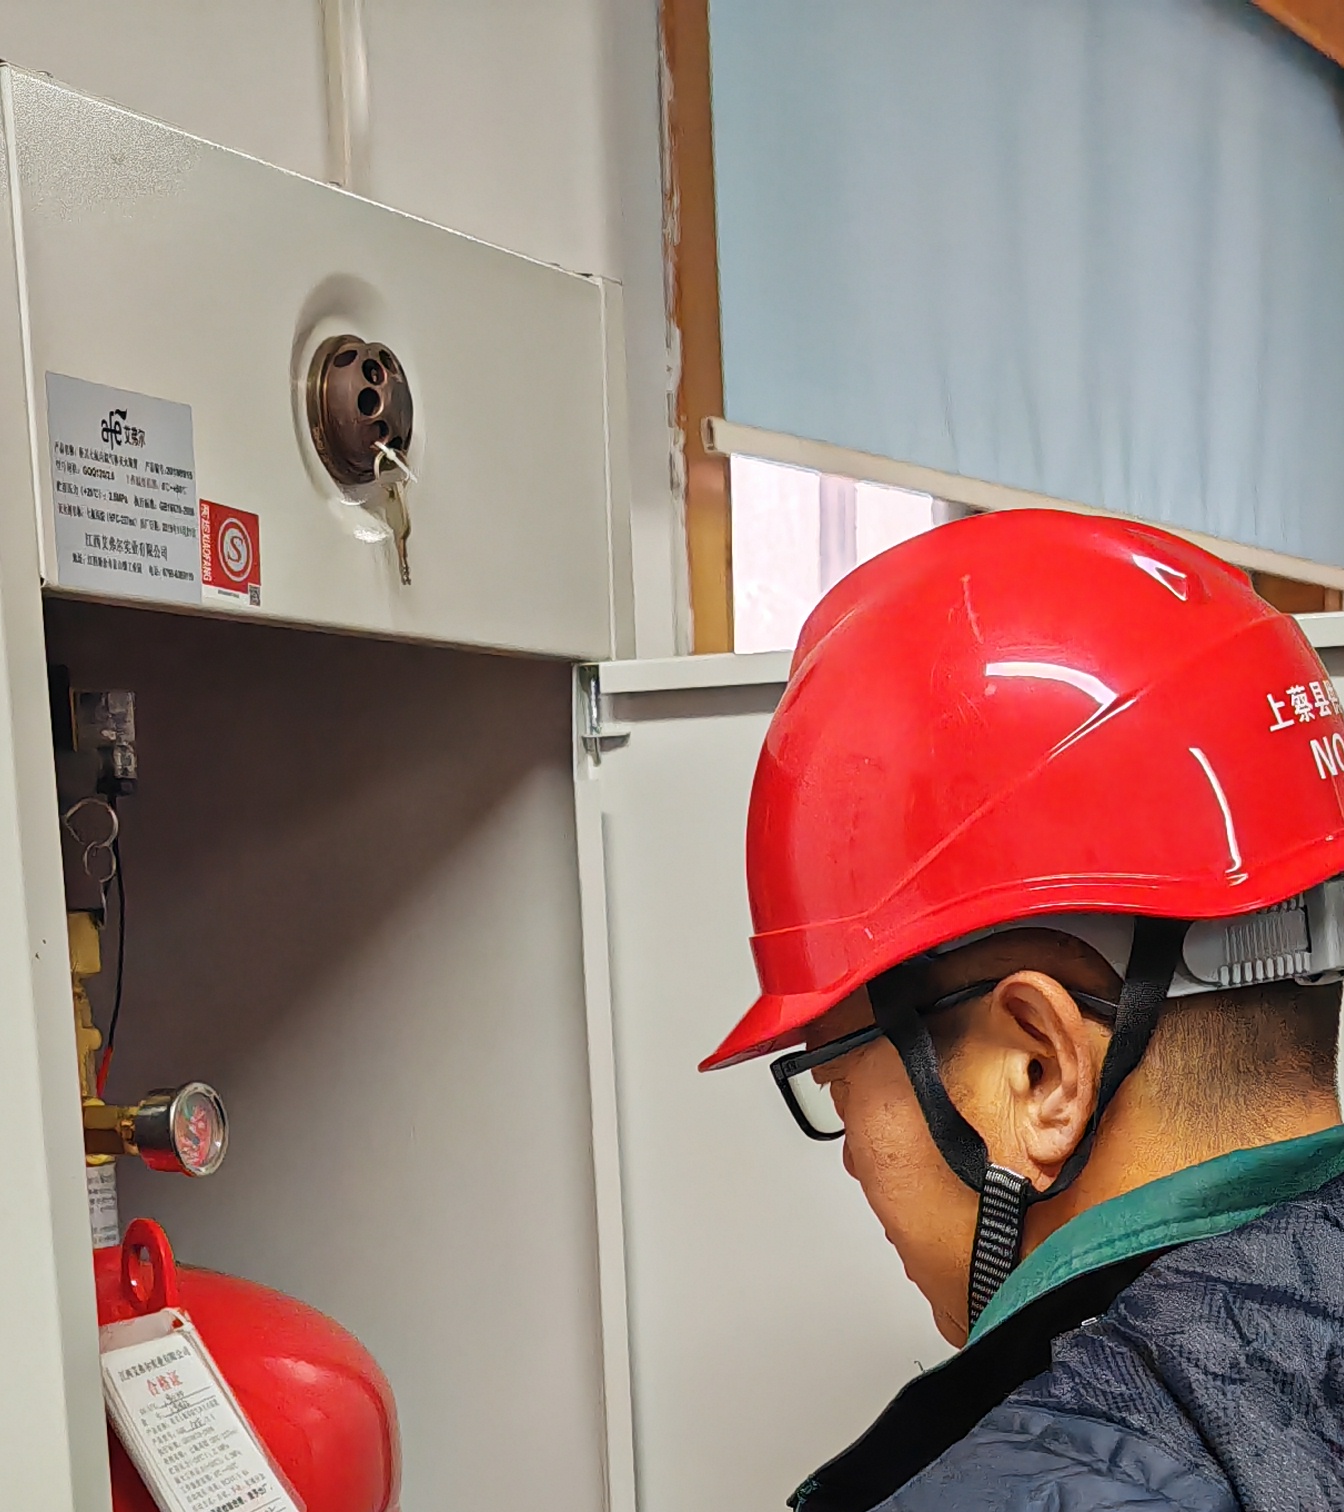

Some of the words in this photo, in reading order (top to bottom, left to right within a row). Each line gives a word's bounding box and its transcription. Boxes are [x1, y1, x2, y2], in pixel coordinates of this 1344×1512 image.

[85, 533, 168, 561] 江西艾弗尔实业有限公司
[146, 1369, 183, 1397] 合格证
